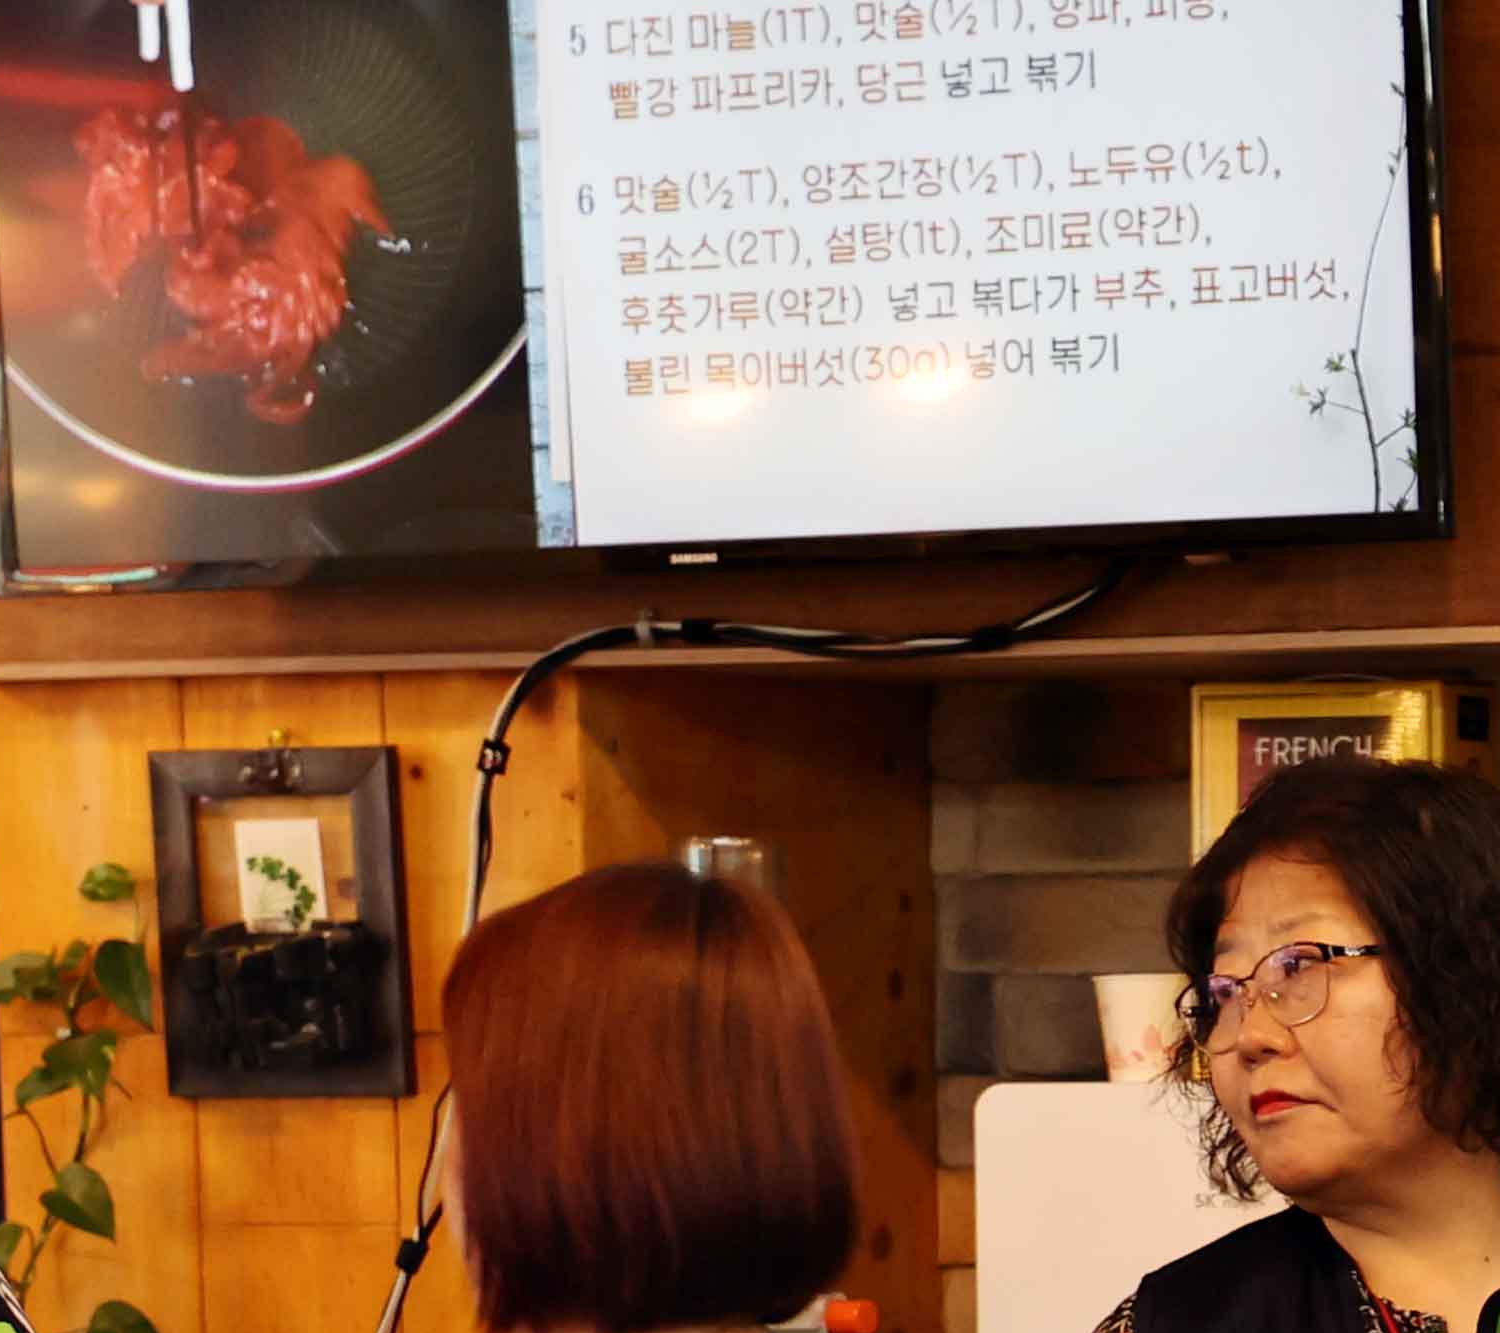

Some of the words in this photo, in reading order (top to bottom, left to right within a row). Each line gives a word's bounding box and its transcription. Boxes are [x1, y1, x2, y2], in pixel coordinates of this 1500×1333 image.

[569, 26, 587, 57] 5
[606, 15, 674, 57] 다진
[688, 5, 843, 51] 마늘(1T),
[610, 78, 678, 121] 빨강
[691, 68, 844, 113] 파프리카,
[856, 61, 926, 104] 당근
[941, 56, 1011, 100] 넣고
[1027, 50, 1098, 94] 볶기
[577, 183, 595, 216] 6
[617, 226, 812, 277] 굴소스(2T),
[826, 218, 973, 266] 설탕(1t),
[985, 201, 1213, 255] 조미료(약간),
[621, 285, 863, 335] 후춧가루(약간)
[887, 280, 957, 323] 넣고
[972, 272, 1081, 318] 볶다가
[1094, 266, 1177, 312] 부추,
[1190, 258, 1350, 307] 표고버섯,
[624, 354, 692, 398] 불린
[964, 337, 1036, 381] 넣어
[1051, 332, 1122, 376] 볶기
